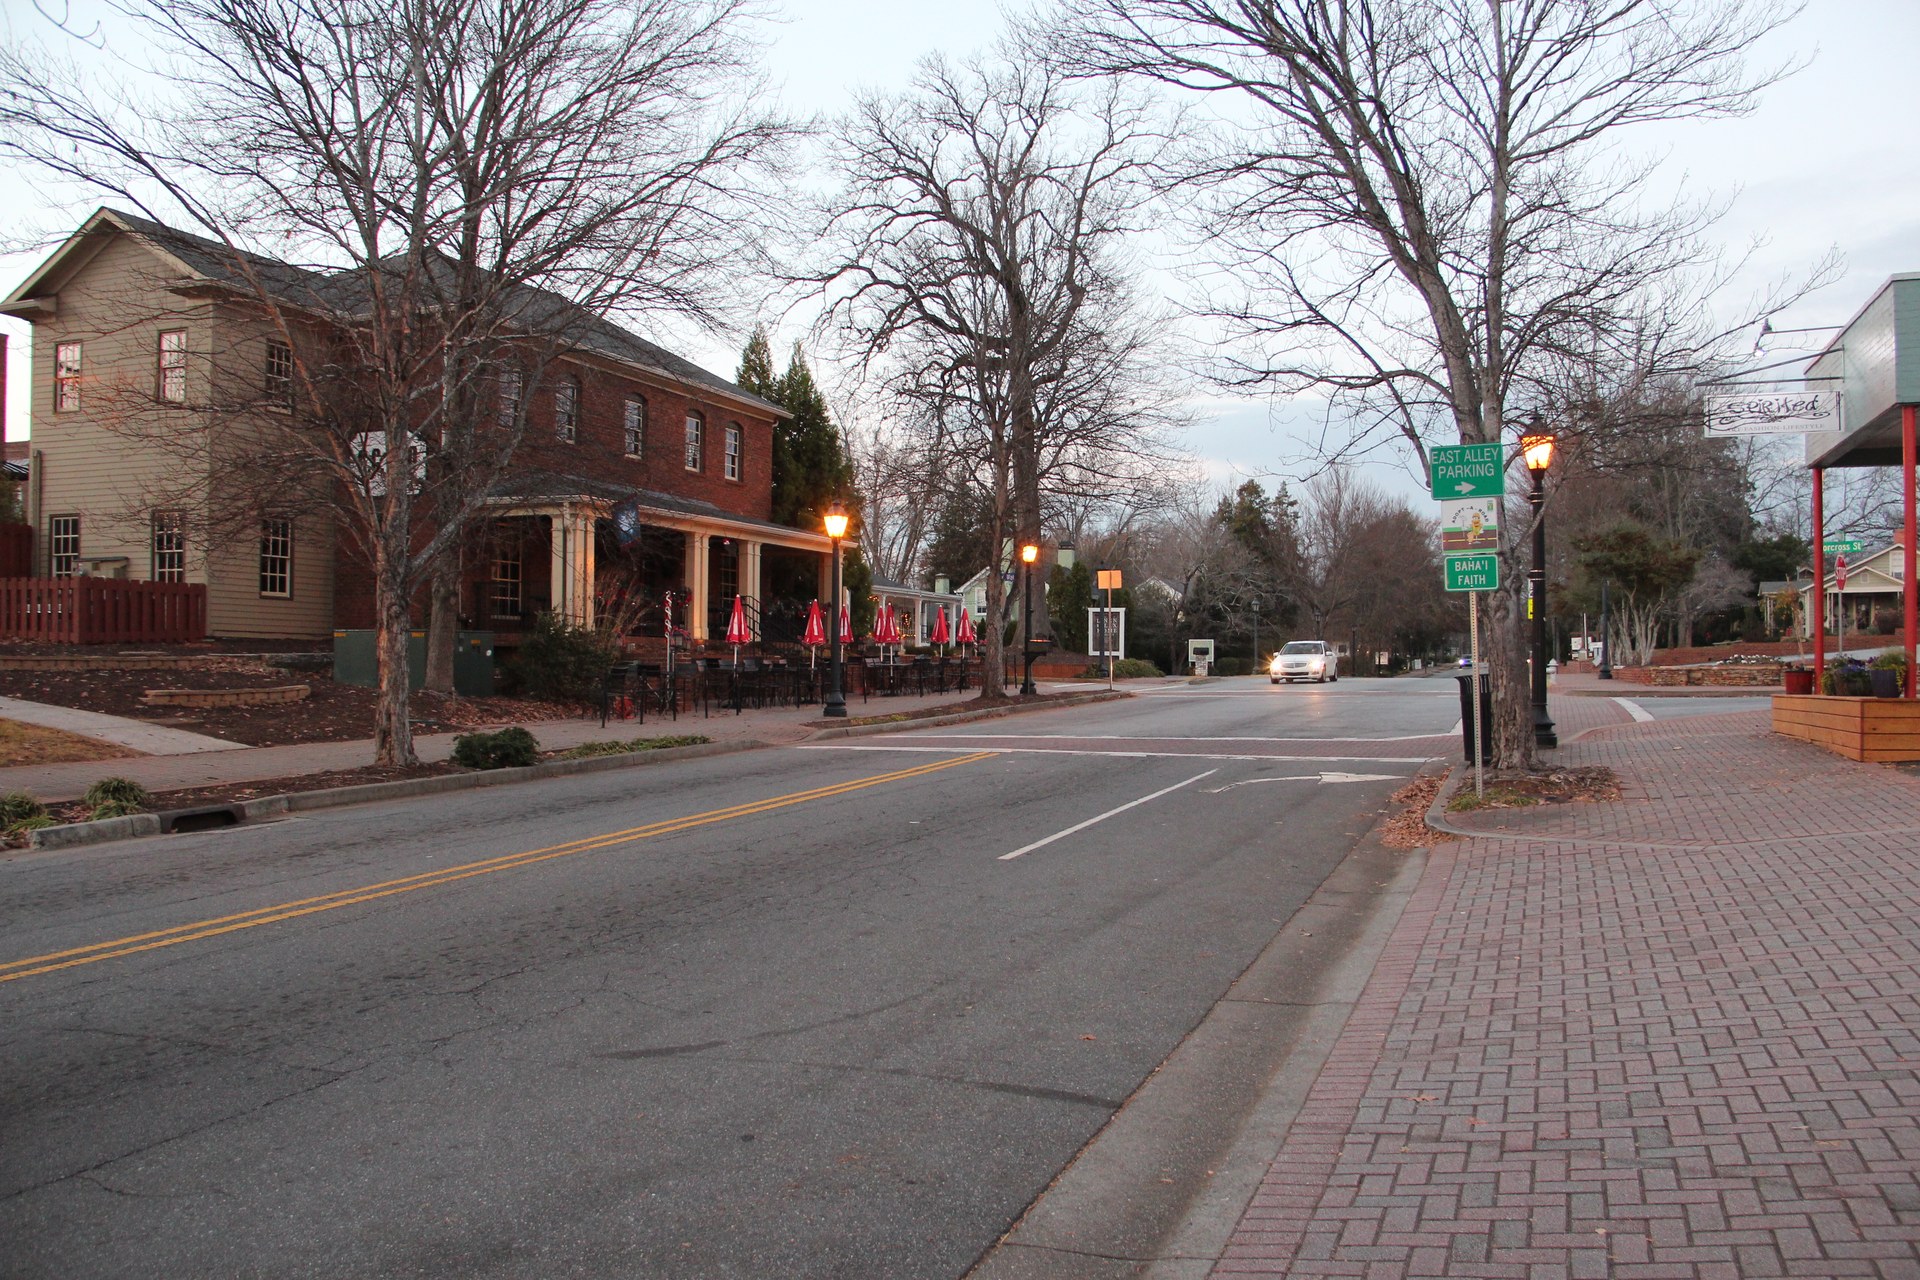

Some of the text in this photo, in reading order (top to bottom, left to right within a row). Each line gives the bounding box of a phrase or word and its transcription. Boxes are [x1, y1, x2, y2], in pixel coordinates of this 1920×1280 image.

[1431, 447, 1499, 464] EAST ALLEY
[1438, 463, 1495, 479] PARKING
[1823, 542, 1862, 552] orcross St
[1454, 560, 1489, 572] BAHA'I
[1457, 574, 1486, 586] FAITH
